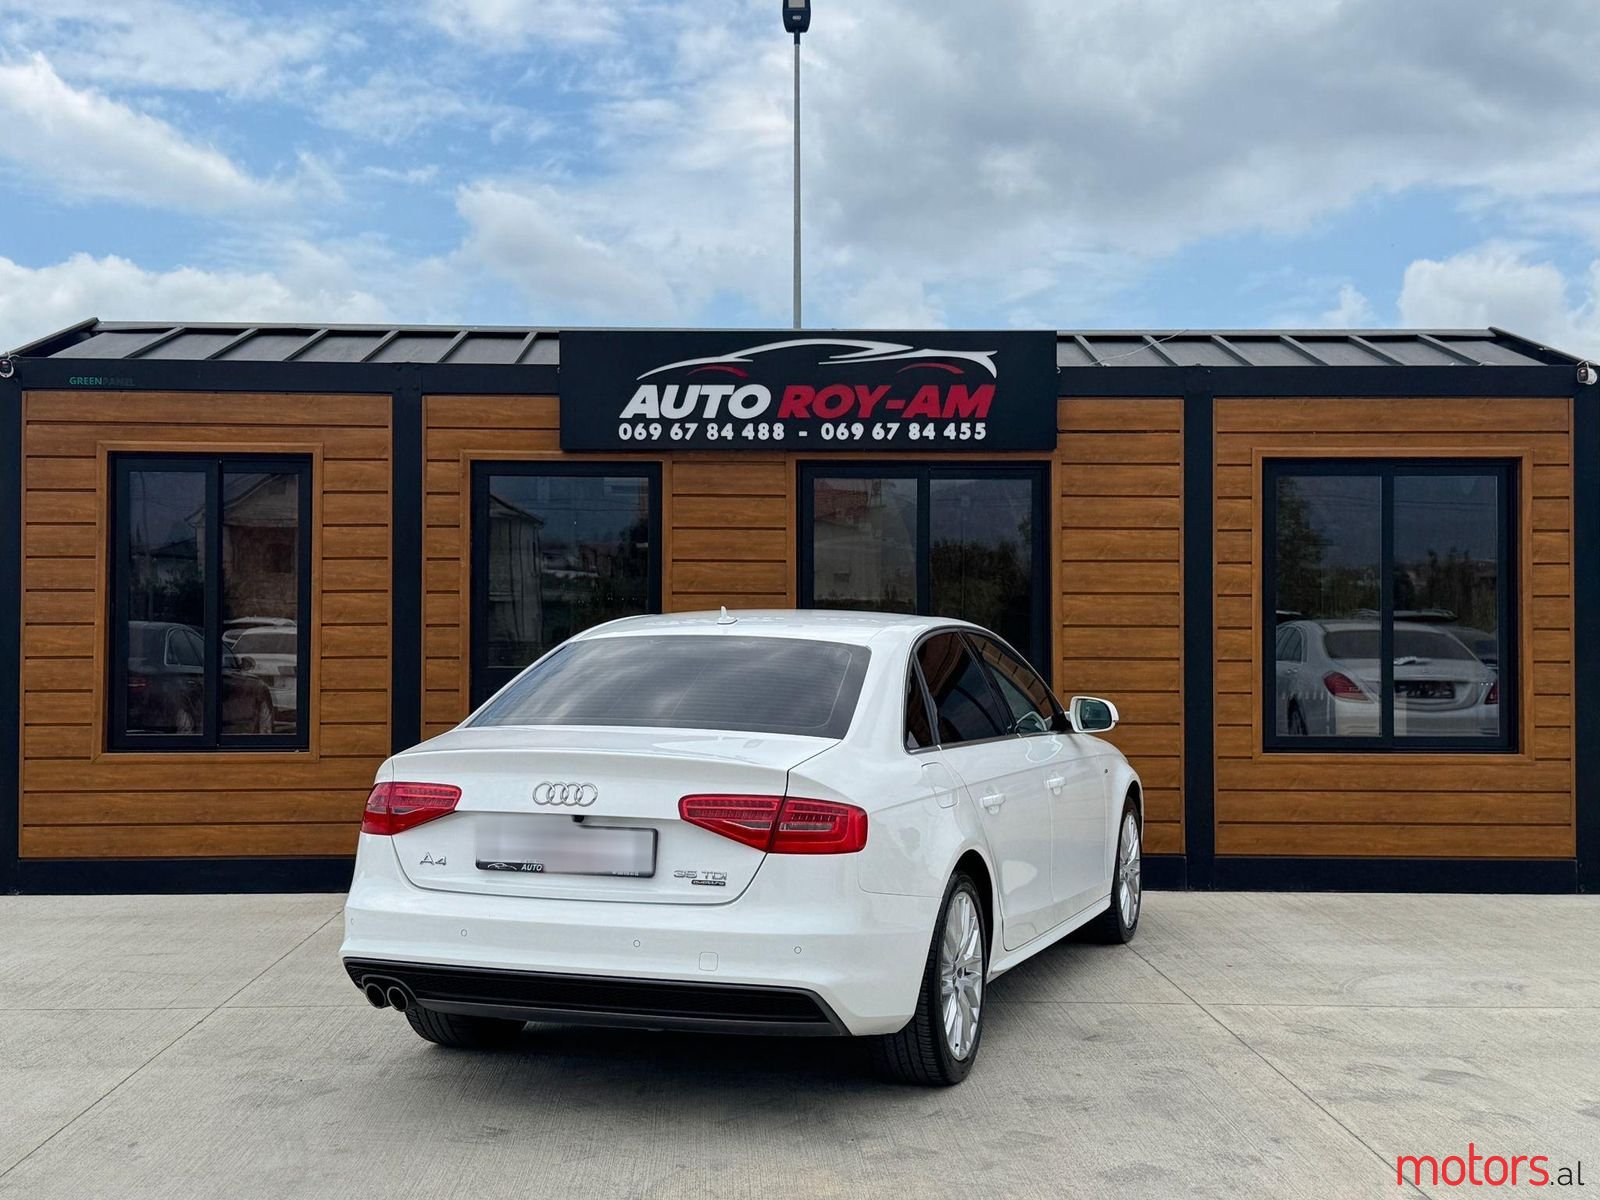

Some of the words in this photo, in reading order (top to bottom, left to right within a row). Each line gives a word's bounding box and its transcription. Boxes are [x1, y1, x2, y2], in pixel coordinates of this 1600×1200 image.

[618, 384, 772, 419] AUTO
[776, 384, 997, 419] ROY-AM
[618, 423, 663, 440] 069
[670, 423, 699, 440] 67
[706, 423, 735, 440] 84
[741, 423, 785, 440] 488
[820, 422, 865, 440] 069
[871, 422, 901, 440] 67
[908, 422, 936, 440] 84
[942, 422, 987, 440] 455
[419, 851, 447, 866] A4
[520, 863, 543, 872] AUTO
